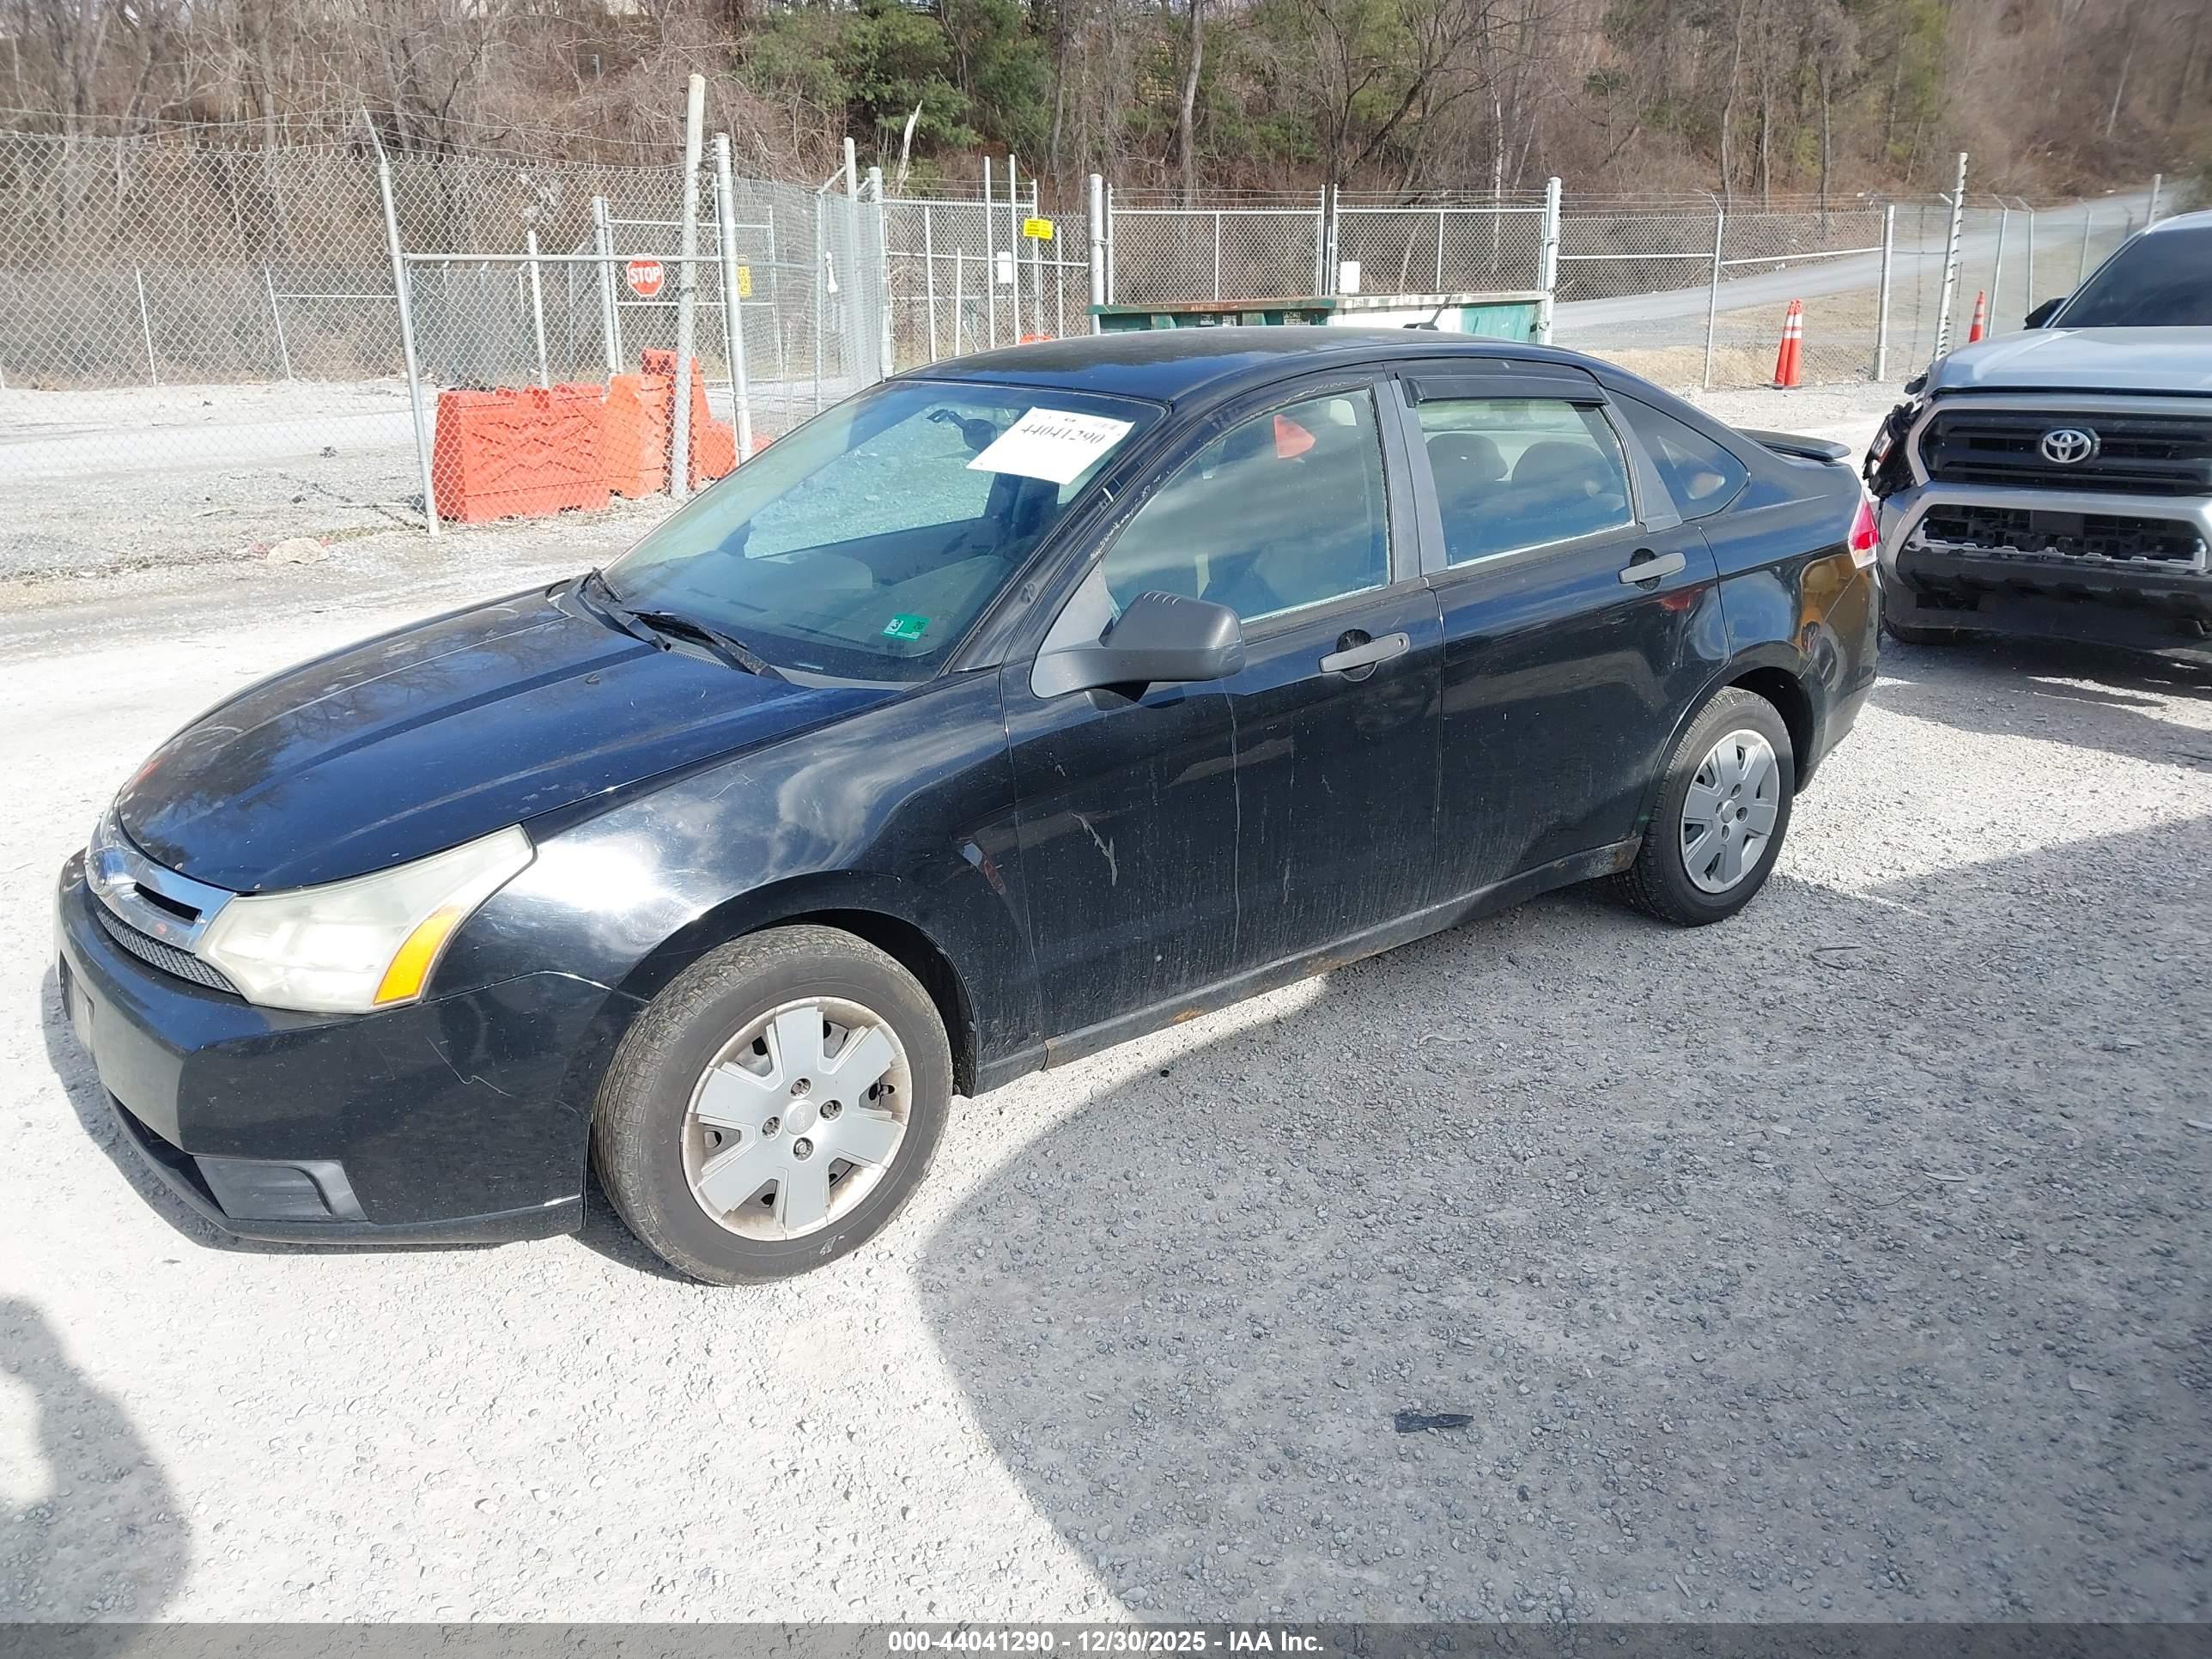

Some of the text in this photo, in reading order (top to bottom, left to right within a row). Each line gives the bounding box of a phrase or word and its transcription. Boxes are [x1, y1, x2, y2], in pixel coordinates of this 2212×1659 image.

[630, 267, 660, 283] STOP
[1021, 424, 1105, 443] 44041290
[891, 620, 901, 629] 3
